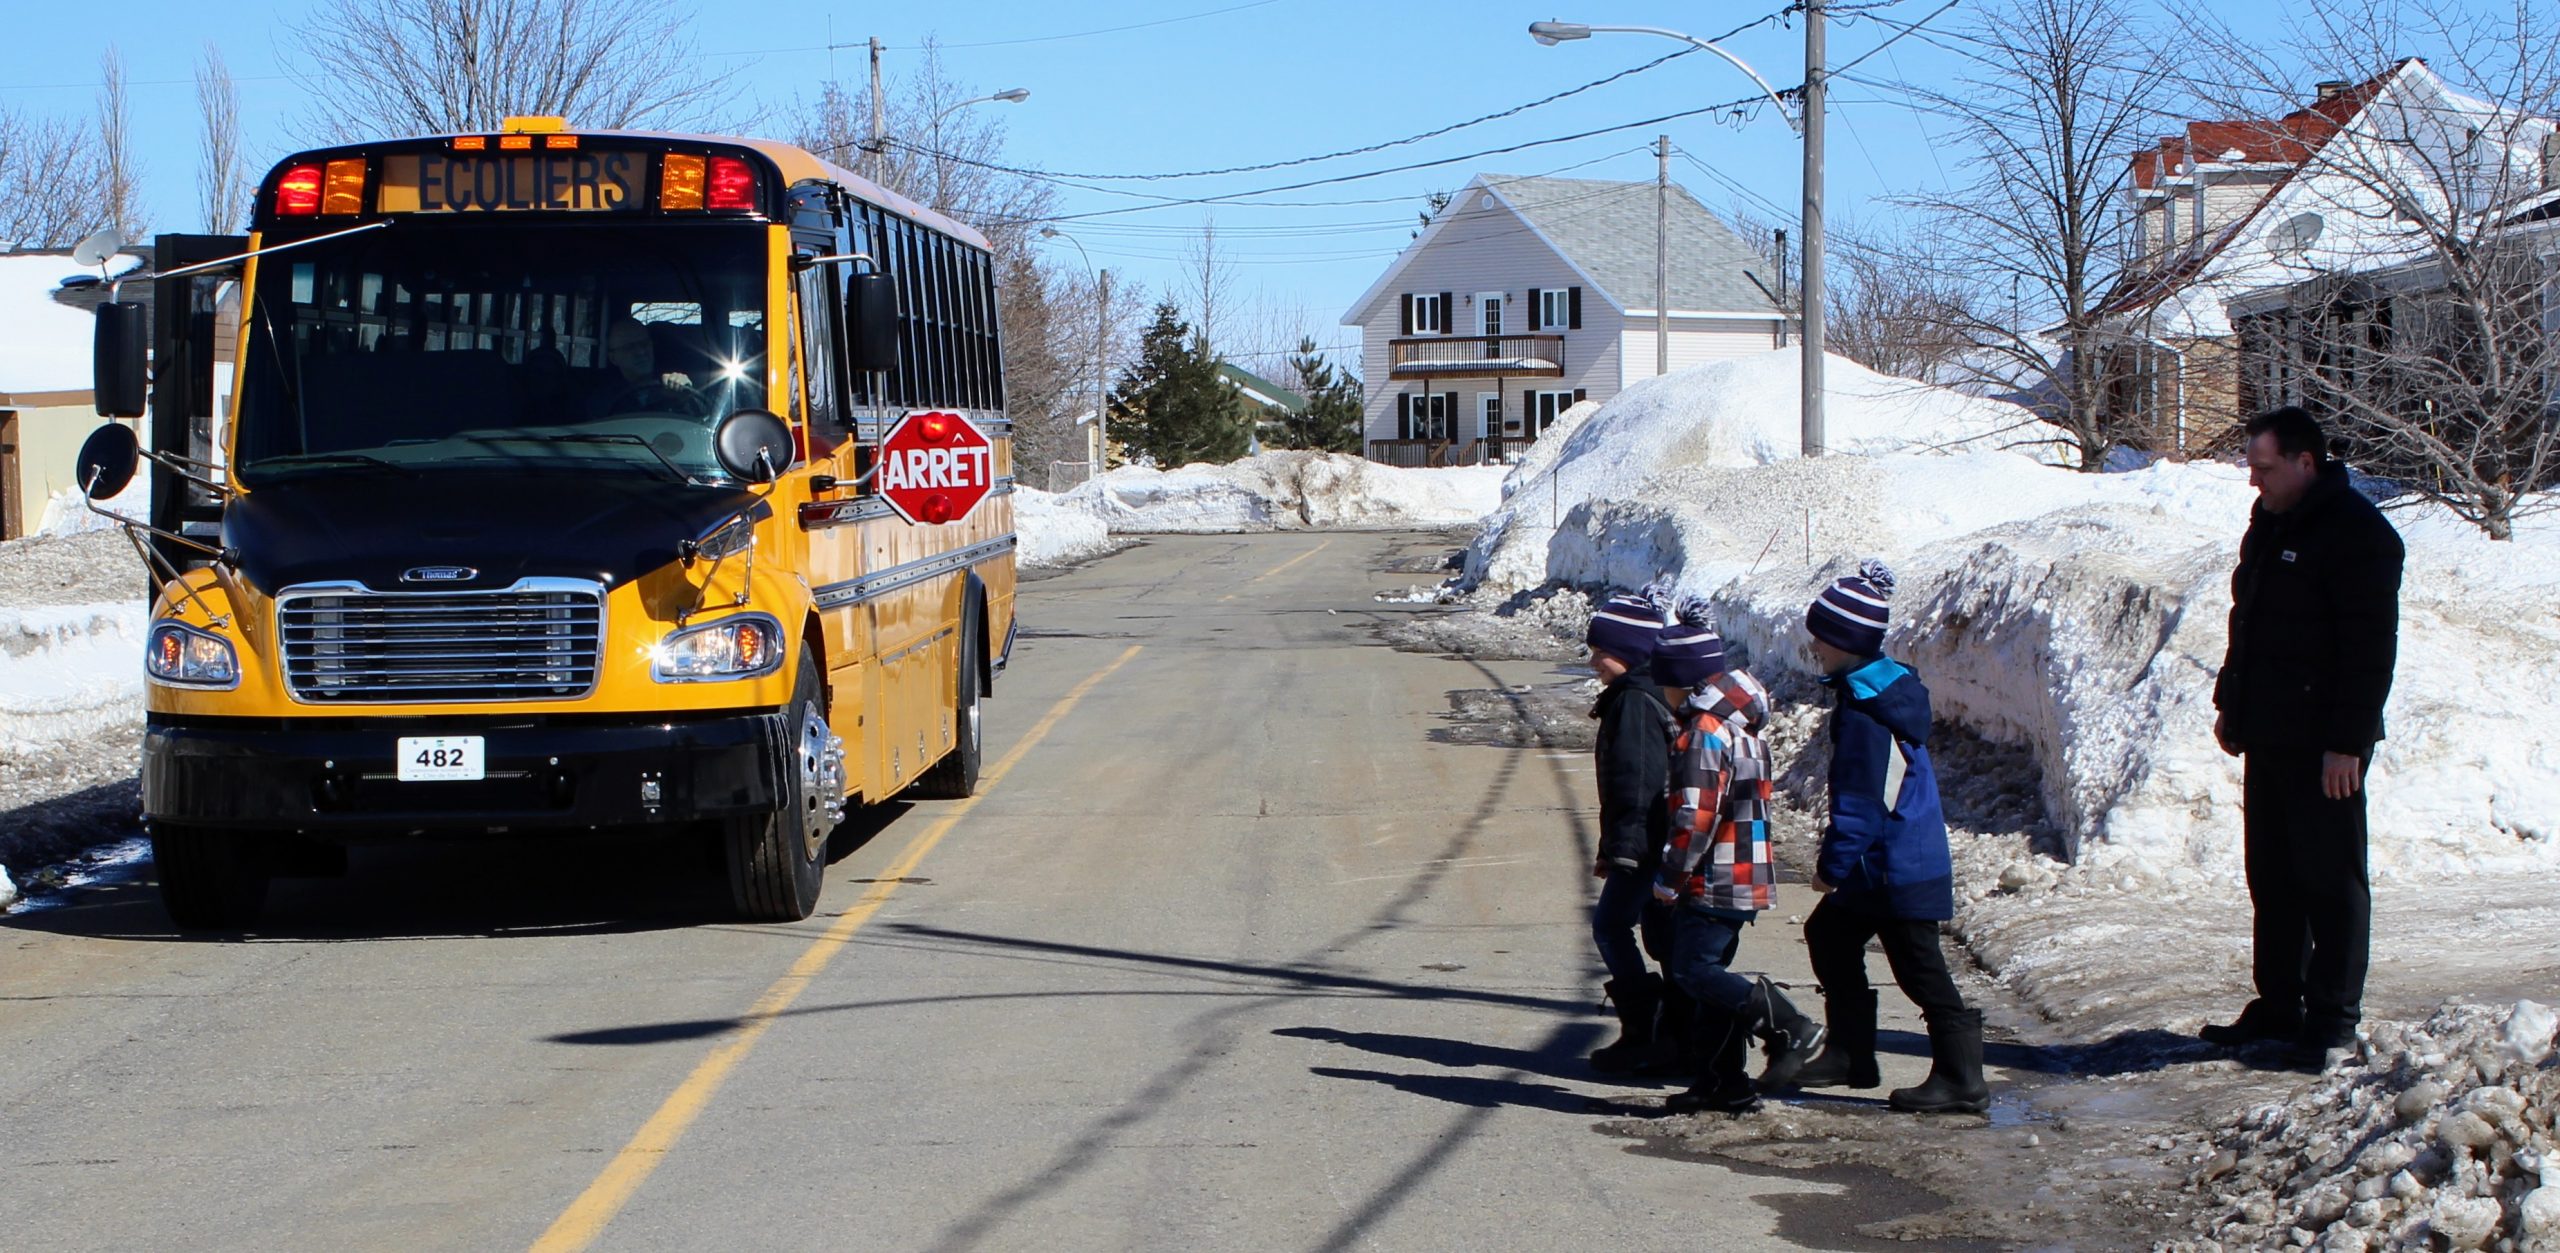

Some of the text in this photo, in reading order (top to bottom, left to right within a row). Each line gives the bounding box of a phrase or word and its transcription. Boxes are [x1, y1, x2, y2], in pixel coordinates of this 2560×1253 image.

[419, 152, 631, 211] ECOLIERS
[885, 432, 988, 490] ARRÊT
[416, 748, 464, 767] 482
